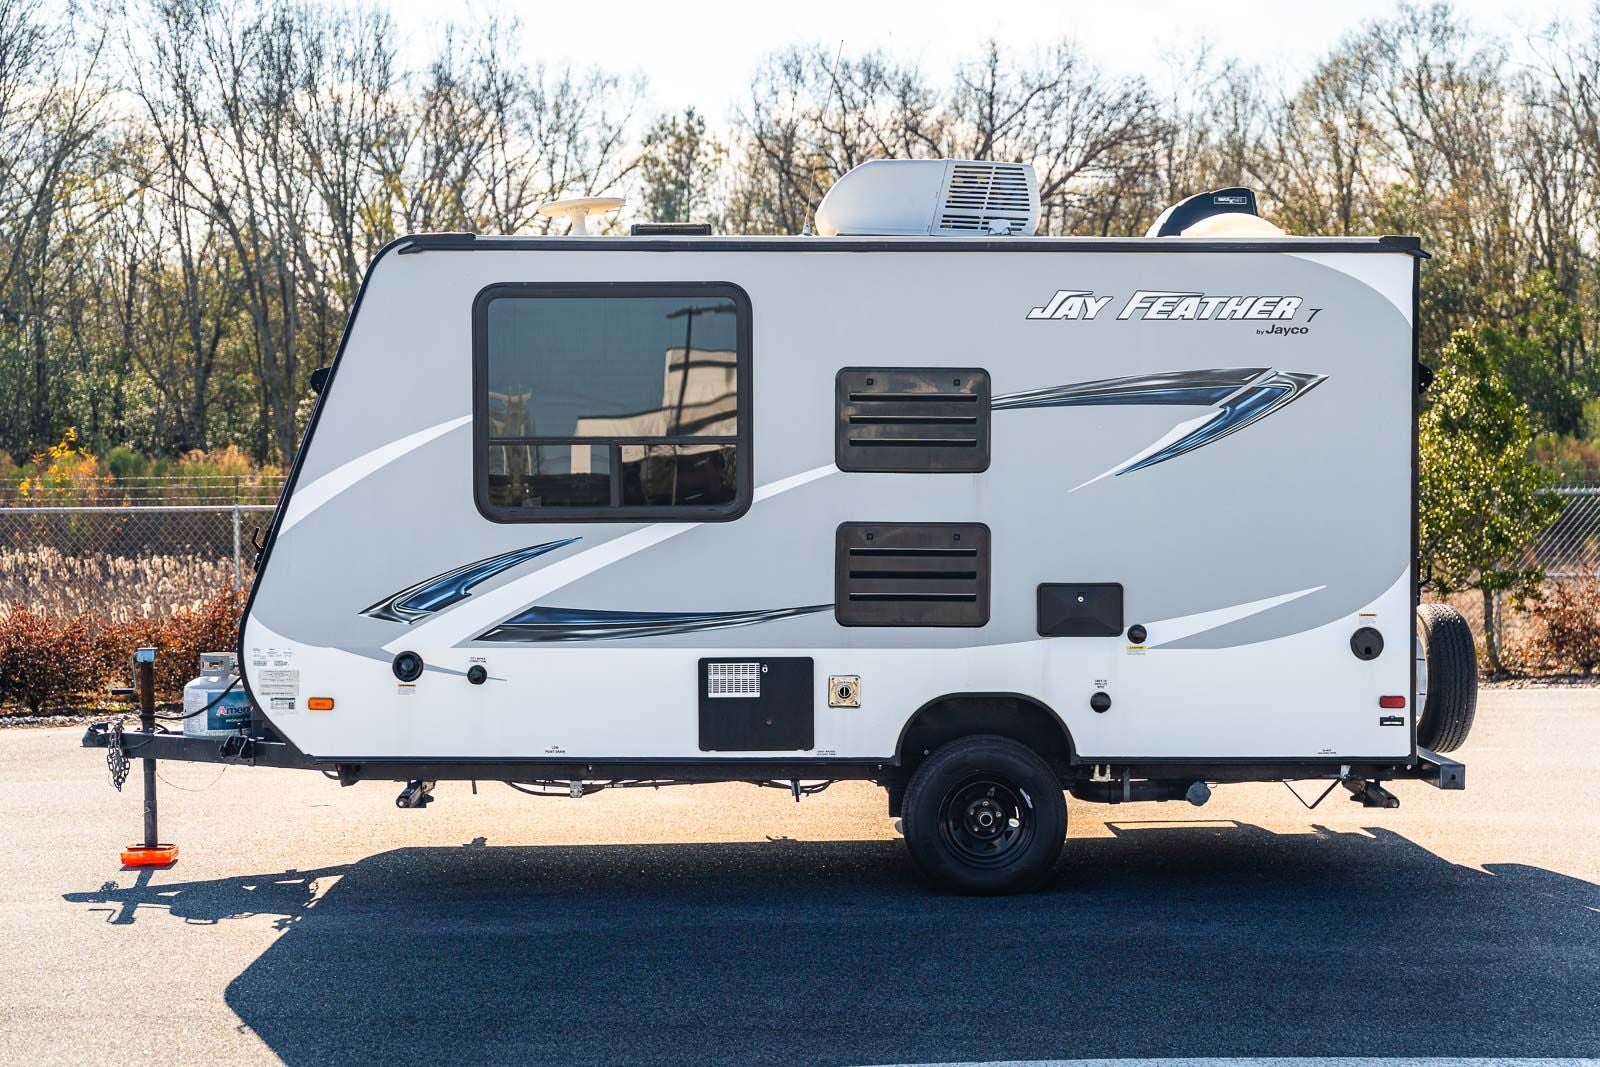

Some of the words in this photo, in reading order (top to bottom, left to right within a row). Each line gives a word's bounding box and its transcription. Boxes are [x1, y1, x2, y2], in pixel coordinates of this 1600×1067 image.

[1026, 290, 1113, 320] JAY
[1116, 290, 1303, 320] FEATHER
[1307, 309, 1322, 322] 7
[1266, 324, 1309, 336] Jayco
